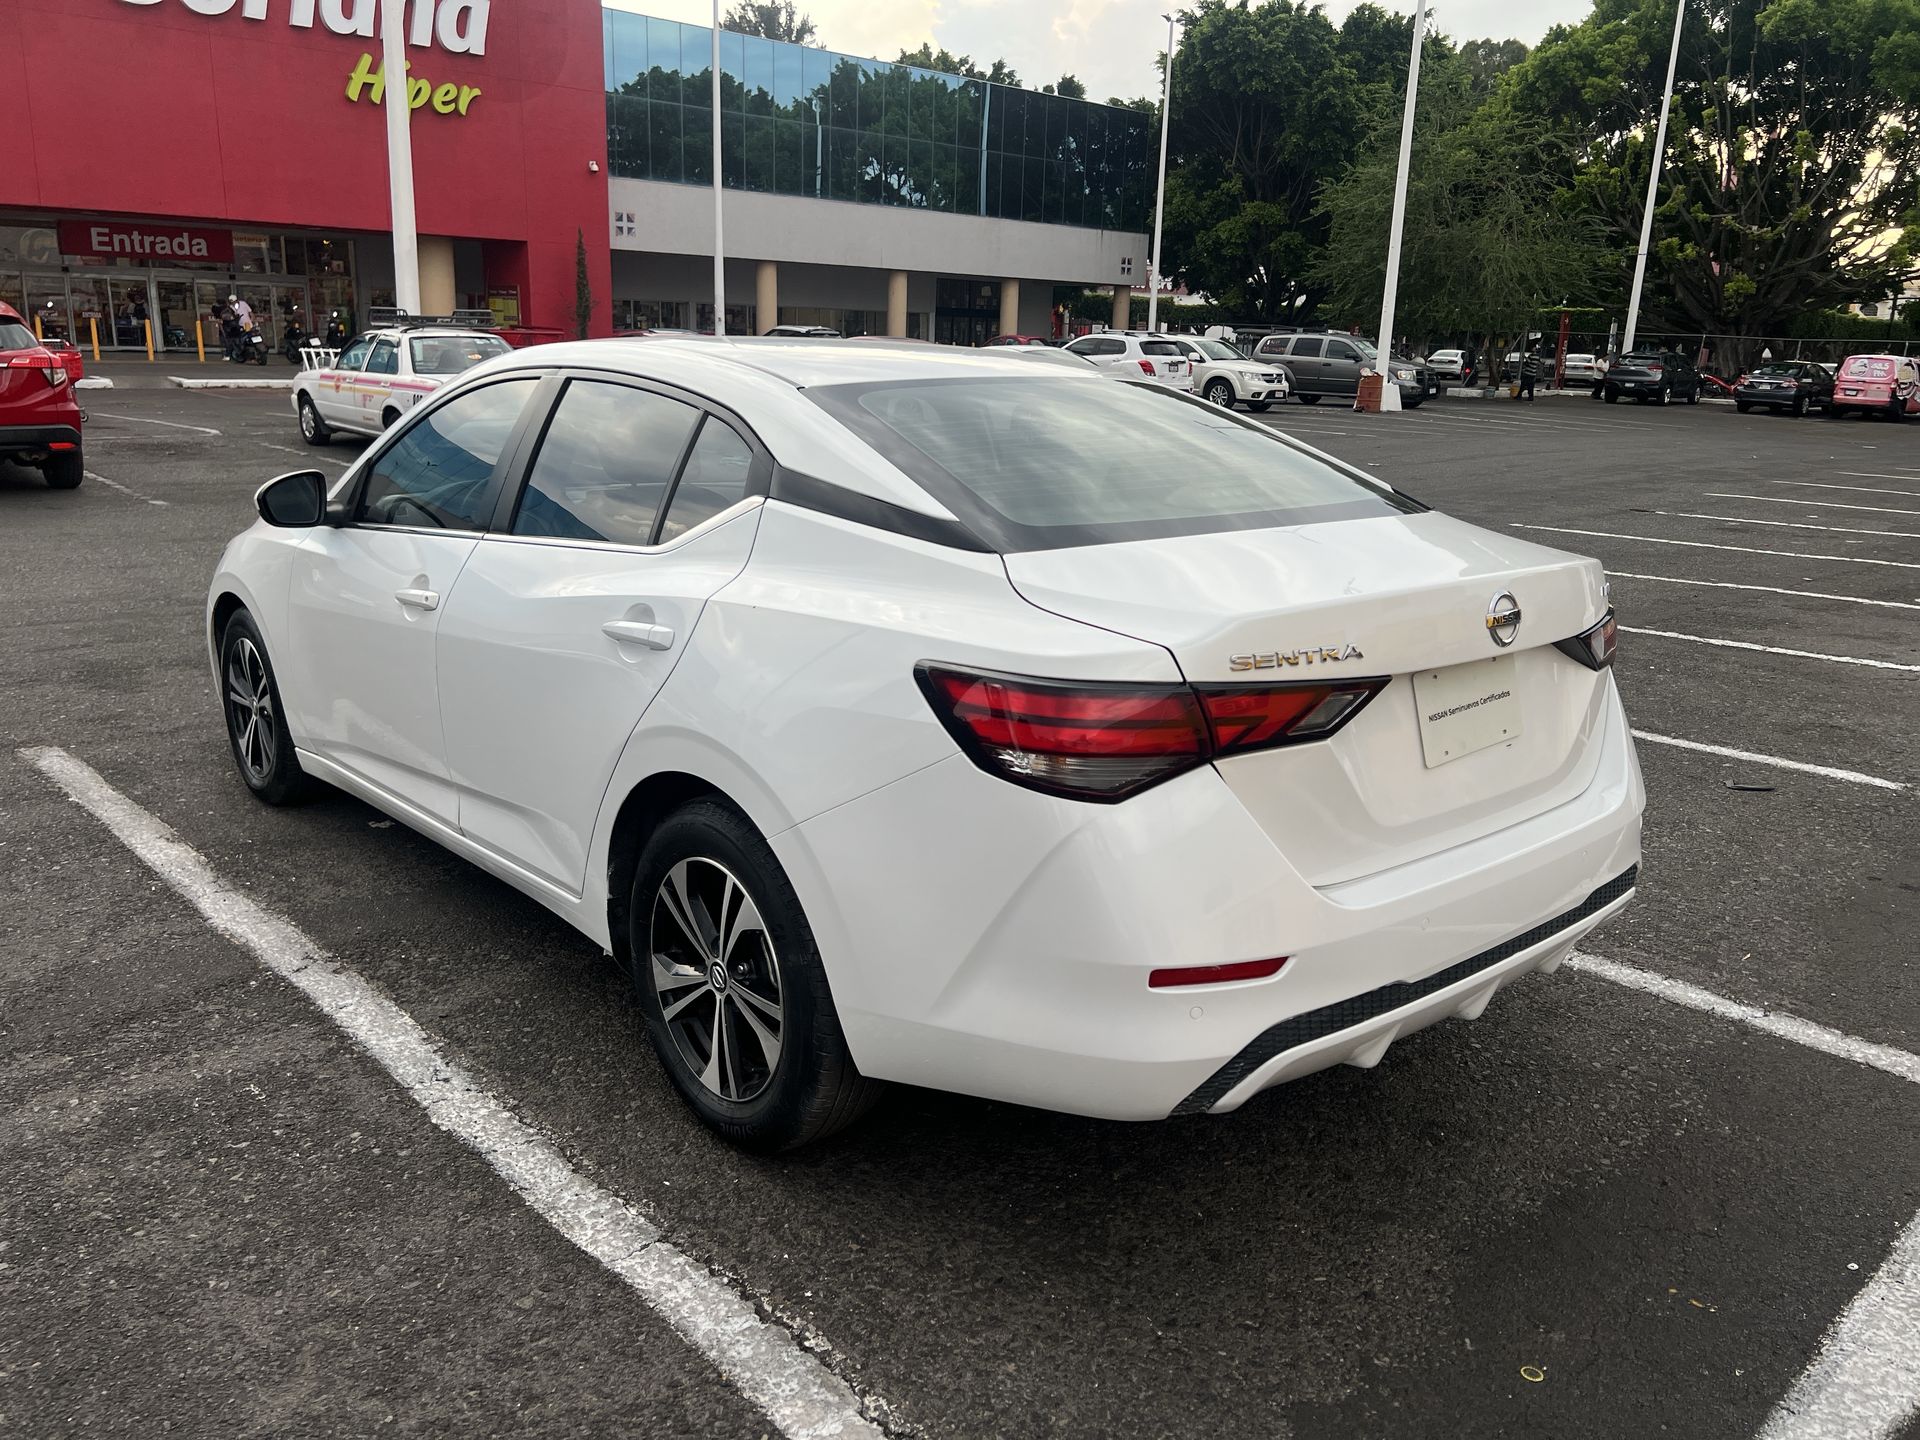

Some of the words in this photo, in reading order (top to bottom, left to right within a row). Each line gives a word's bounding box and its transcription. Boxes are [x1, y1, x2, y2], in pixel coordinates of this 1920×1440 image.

[345, 53, 482, 120] Hper
[90, 226, 208, 257] Entrada
[1492, 610, 1520, 626] NISS
[1229, 643, 1364, 672] SENTRA
[1428, 710, 1448, 723] NISSAN
[1448, 701, 1479, 715] Seminuevos
[1480, 690, 1510, 705] Certificados
